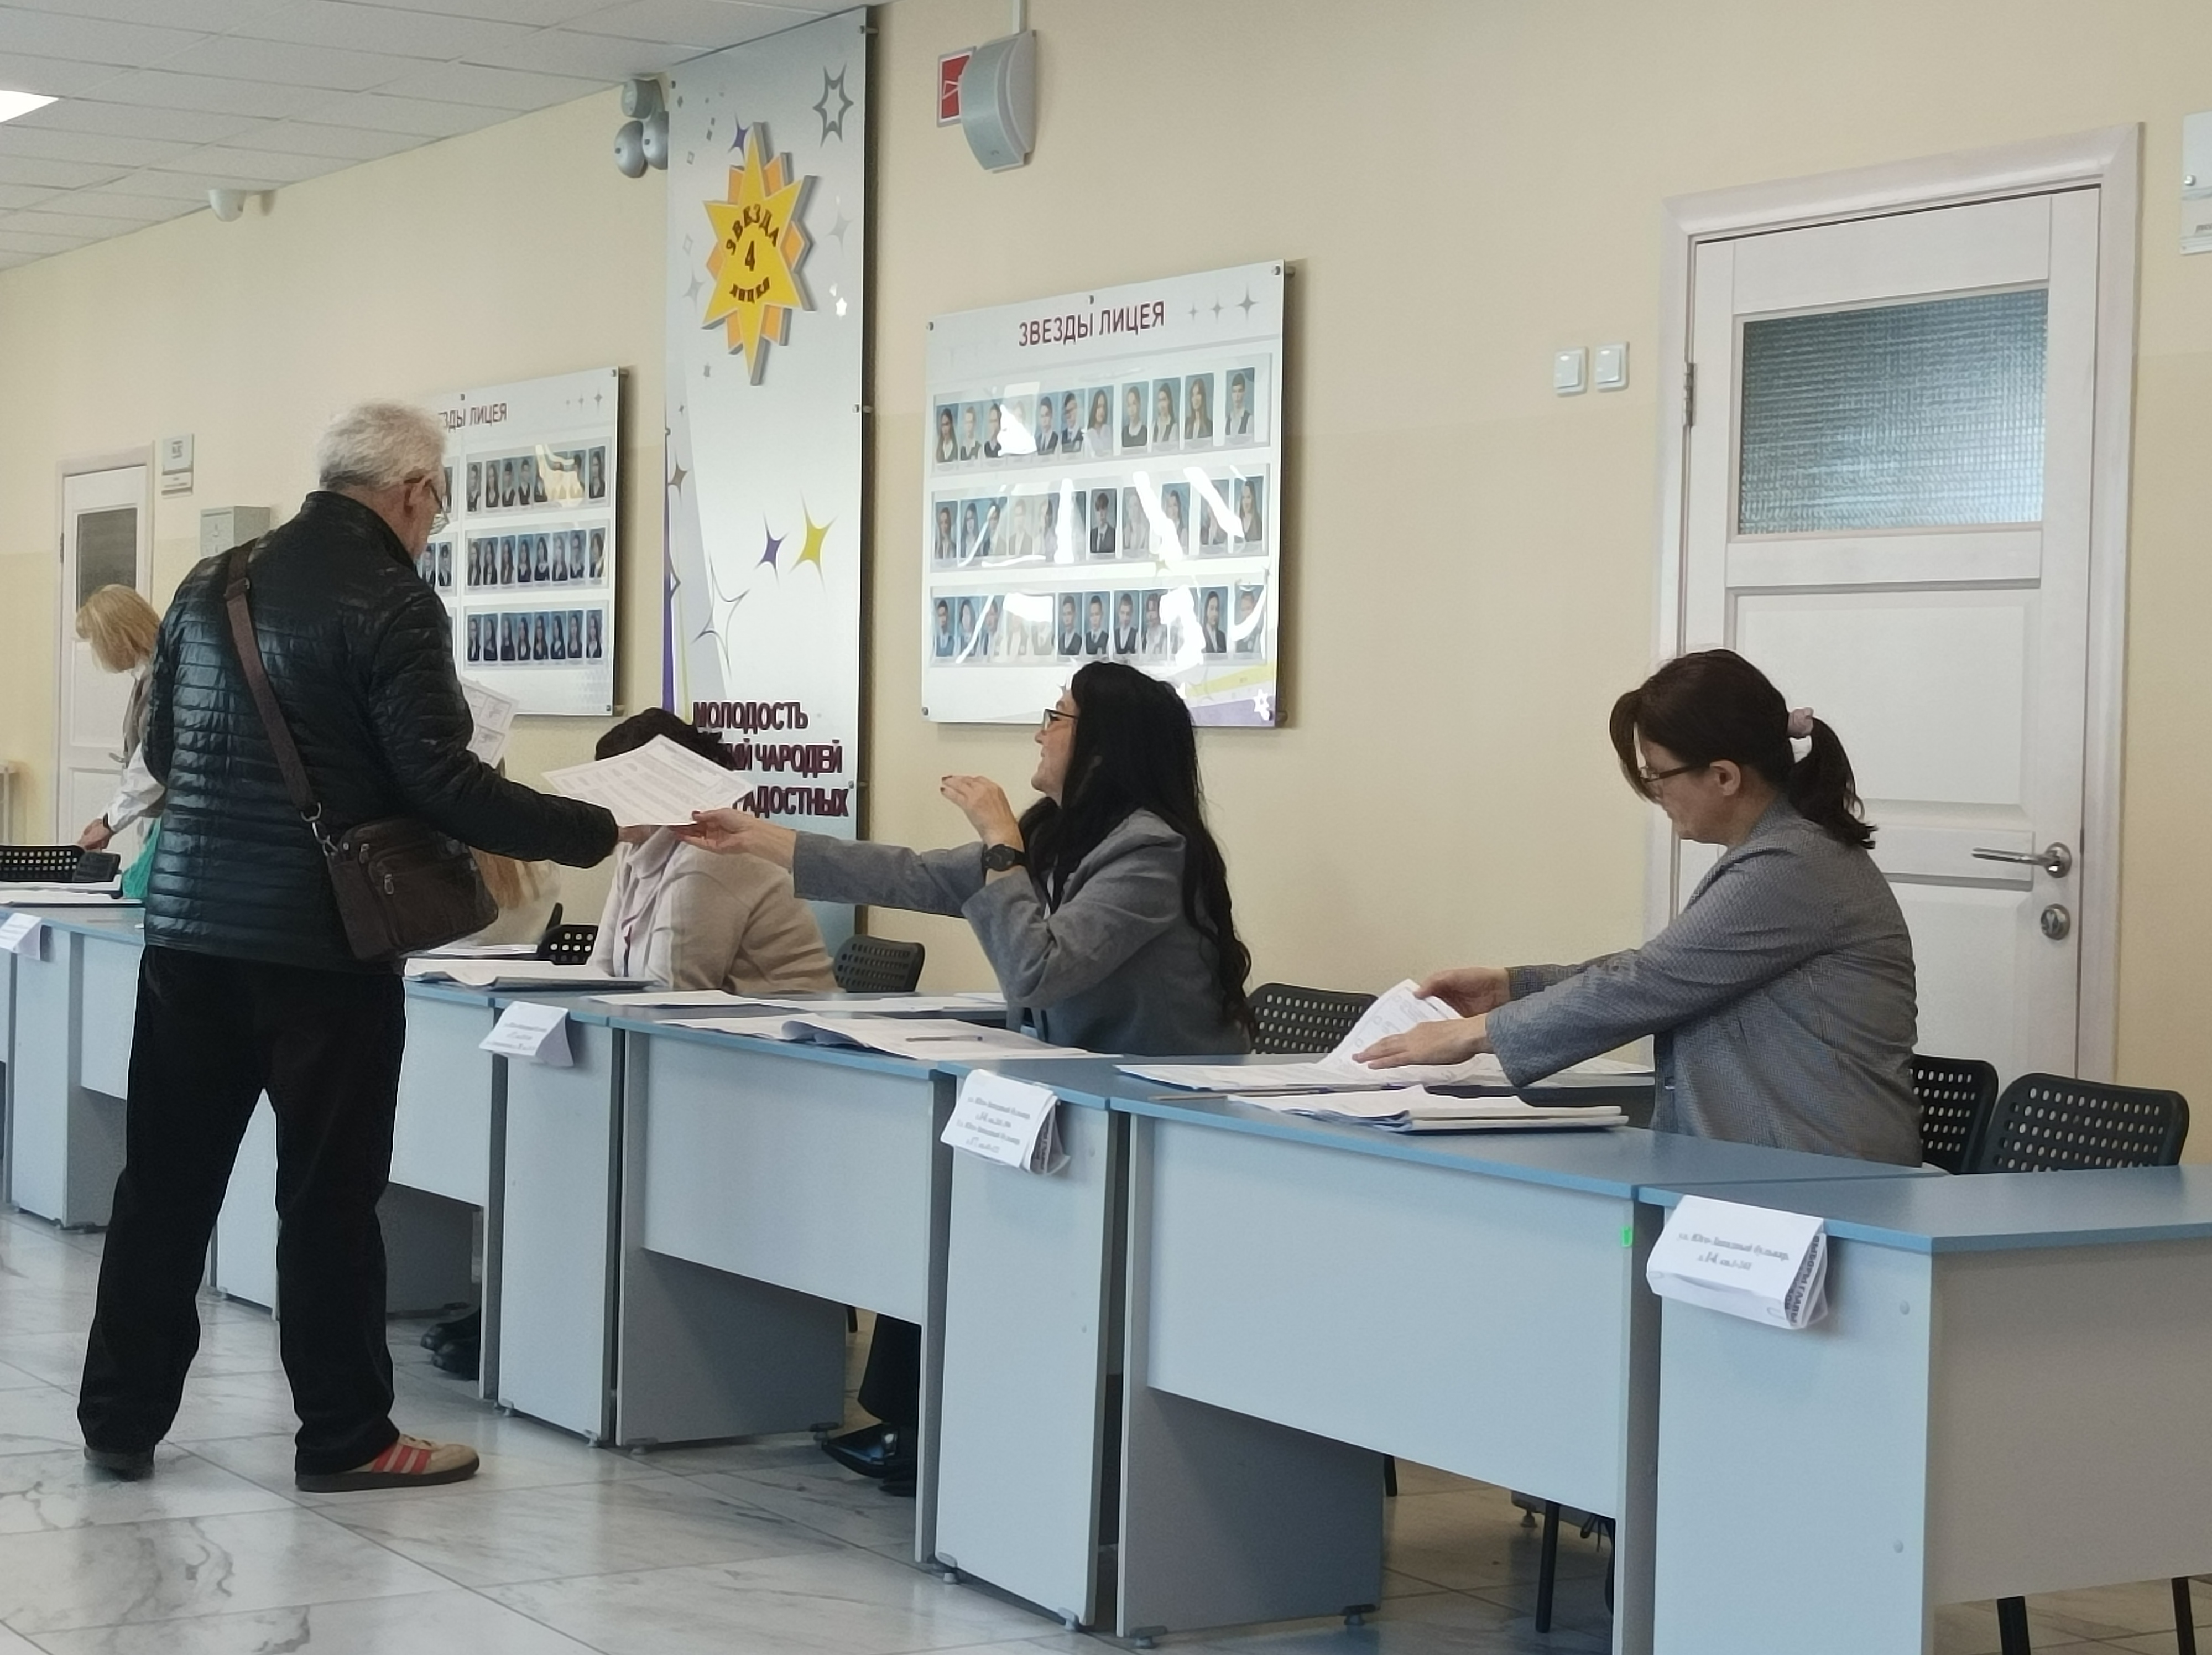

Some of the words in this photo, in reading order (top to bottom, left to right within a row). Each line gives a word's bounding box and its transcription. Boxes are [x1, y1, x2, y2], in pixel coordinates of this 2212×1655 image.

[726, 202, 779, 256] ЗВЕЗДА
[745, 240, 755, 272] 4
[1018, 311, 1094, 347] ЗВЕЗДЫ
[1099, 300, 1165, 336] ЛИЦЕЯ
[438, 408, 466, 433] ЗДЫ
[469, 403, 507, 427] ЛИЦЕЯ
[693, 701, 809, 735] МОЛОДОСТЬ
[755, 739, 843, 779] ЧАРОДЕЙ
